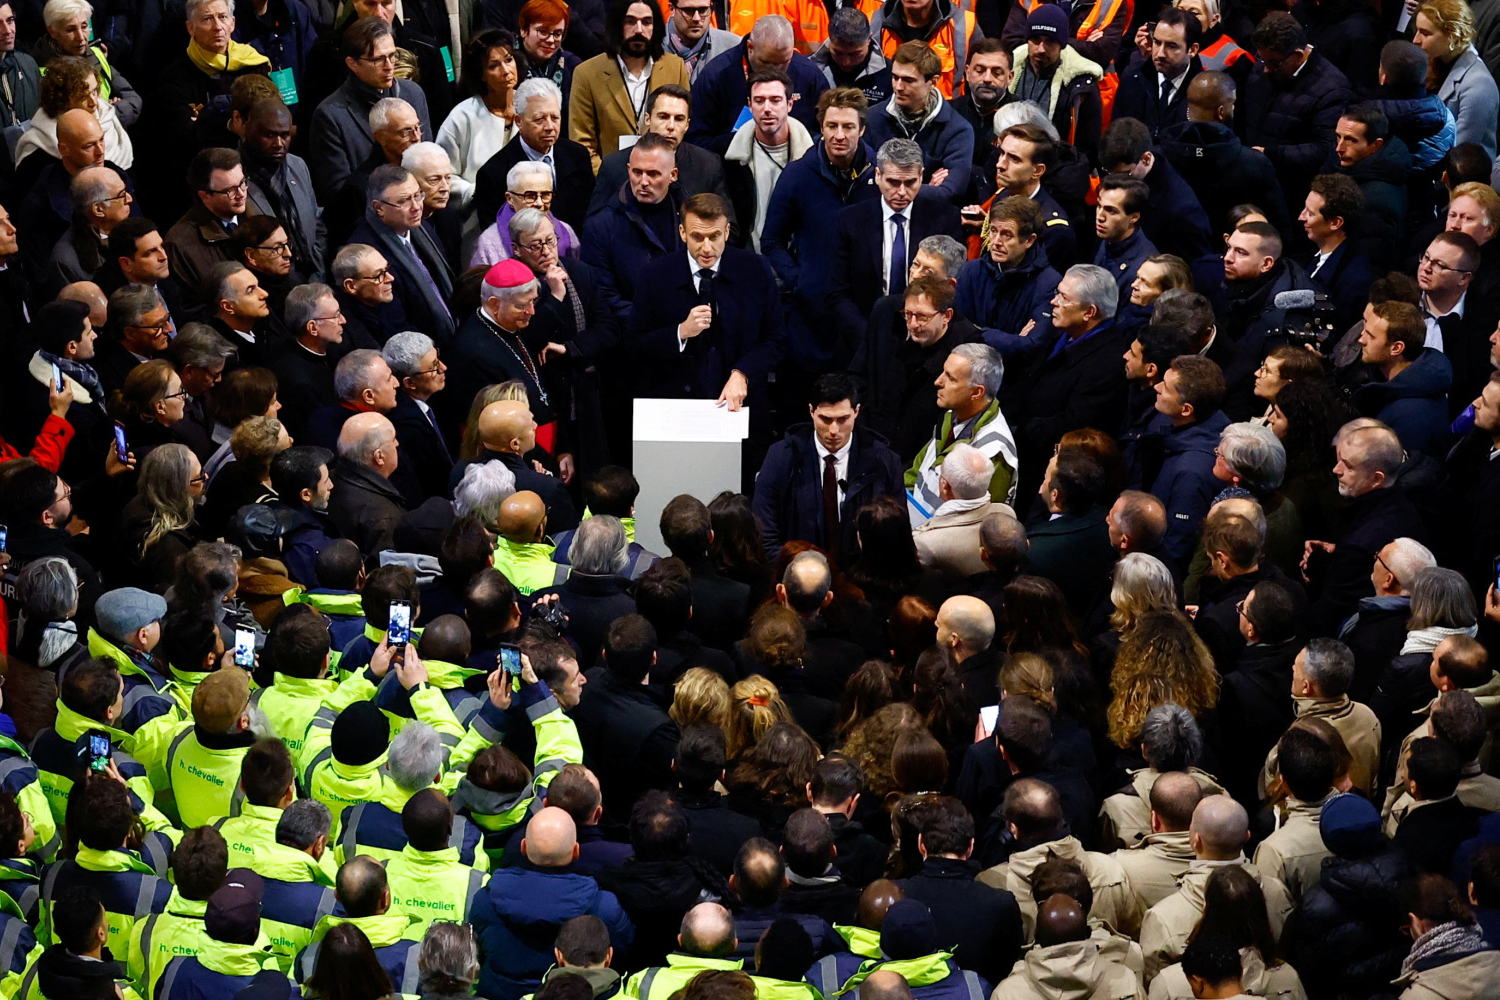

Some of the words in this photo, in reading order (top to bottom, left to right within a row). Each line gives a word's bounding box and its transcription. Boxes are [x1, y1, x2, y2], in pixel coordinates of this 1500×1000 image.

[1031, 24, 1057, 33] HILFIGER
[180, 759, 187, 769] h.
[187, 765, 225, 787] chevalier
[319, 787, 327, 796] h.
[393, 896, 402, 905] h.
[405, 898, 455, 911] chevalier
[160, 943, 169, 953] h.
